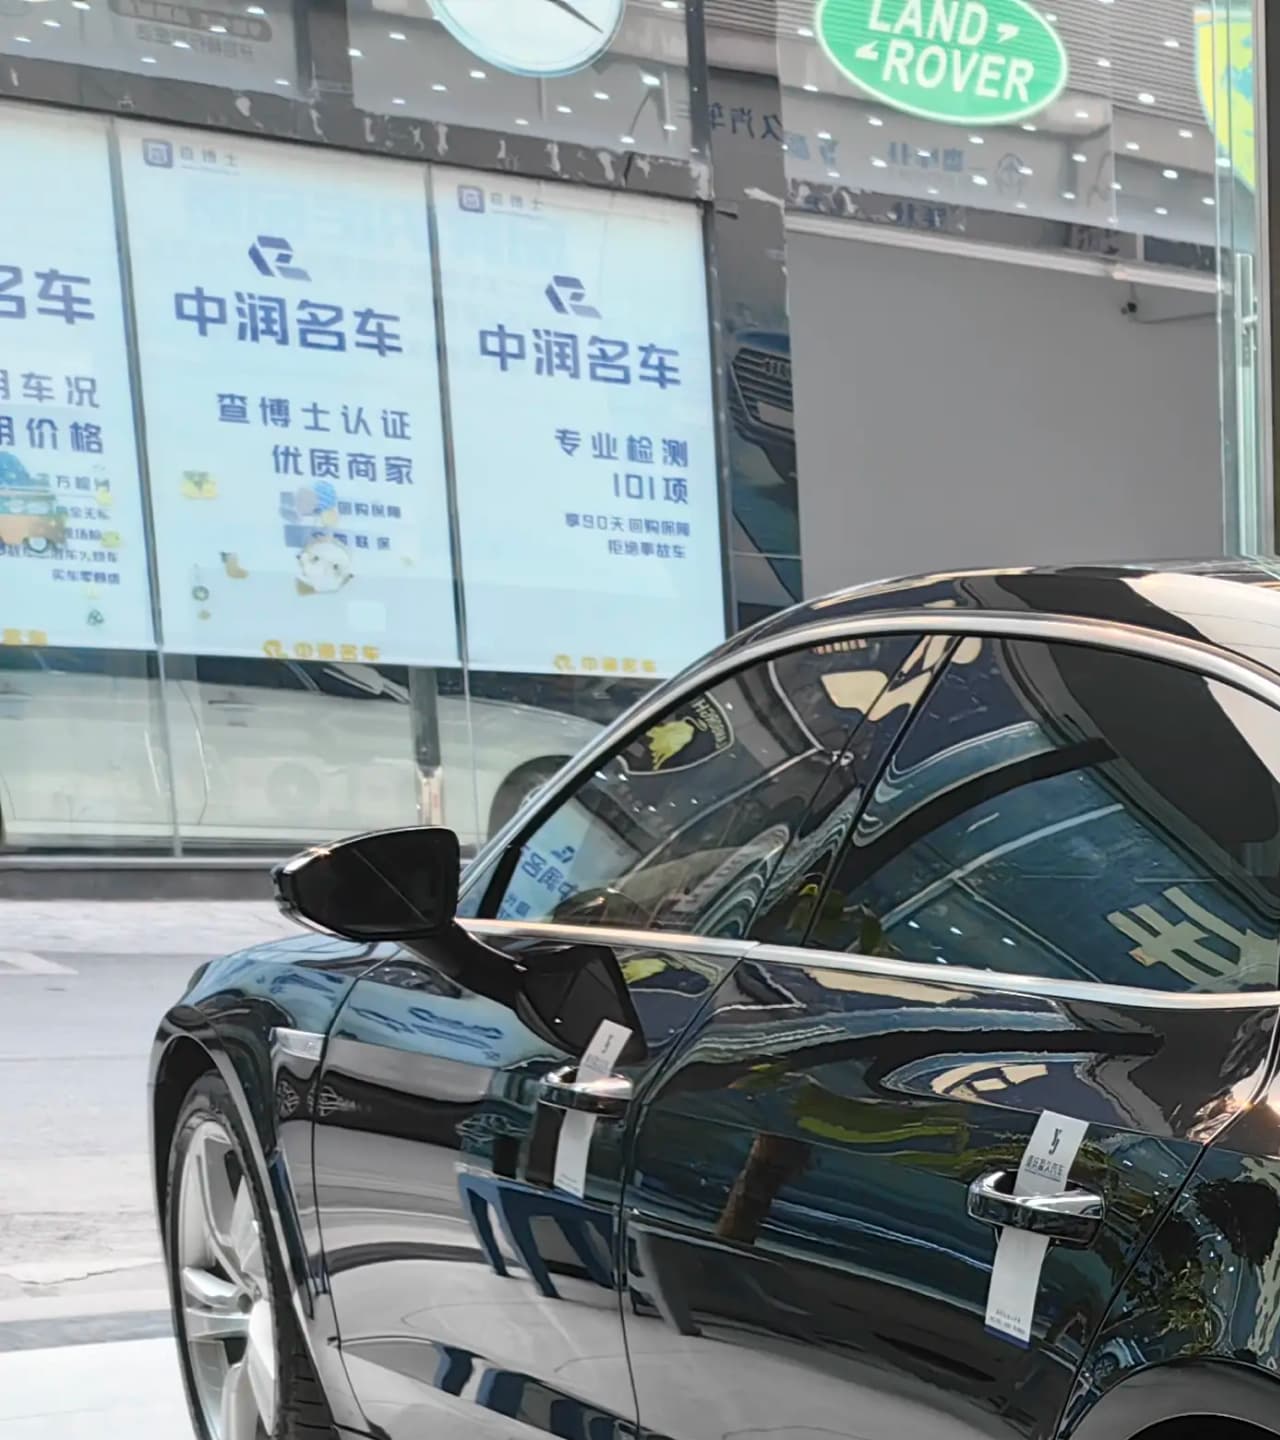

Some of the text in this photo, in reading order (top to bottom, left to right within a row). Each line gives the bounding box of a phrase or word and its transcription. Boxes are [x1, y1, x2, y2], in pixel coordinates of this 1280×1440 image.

[868, 0, 988, 46] LAND
[882, 39, 1034, 103] ROVER
[174, 286, 403, 357] 中润名车
[479, 323, 681, 389] 中润名车
[217, 393, 412, 440] 查博士认证
[272, 444, 414, 485] 优质商家
[555, 428, 689, 467] 专业检测
[613, 473, 689, 505] 101项
